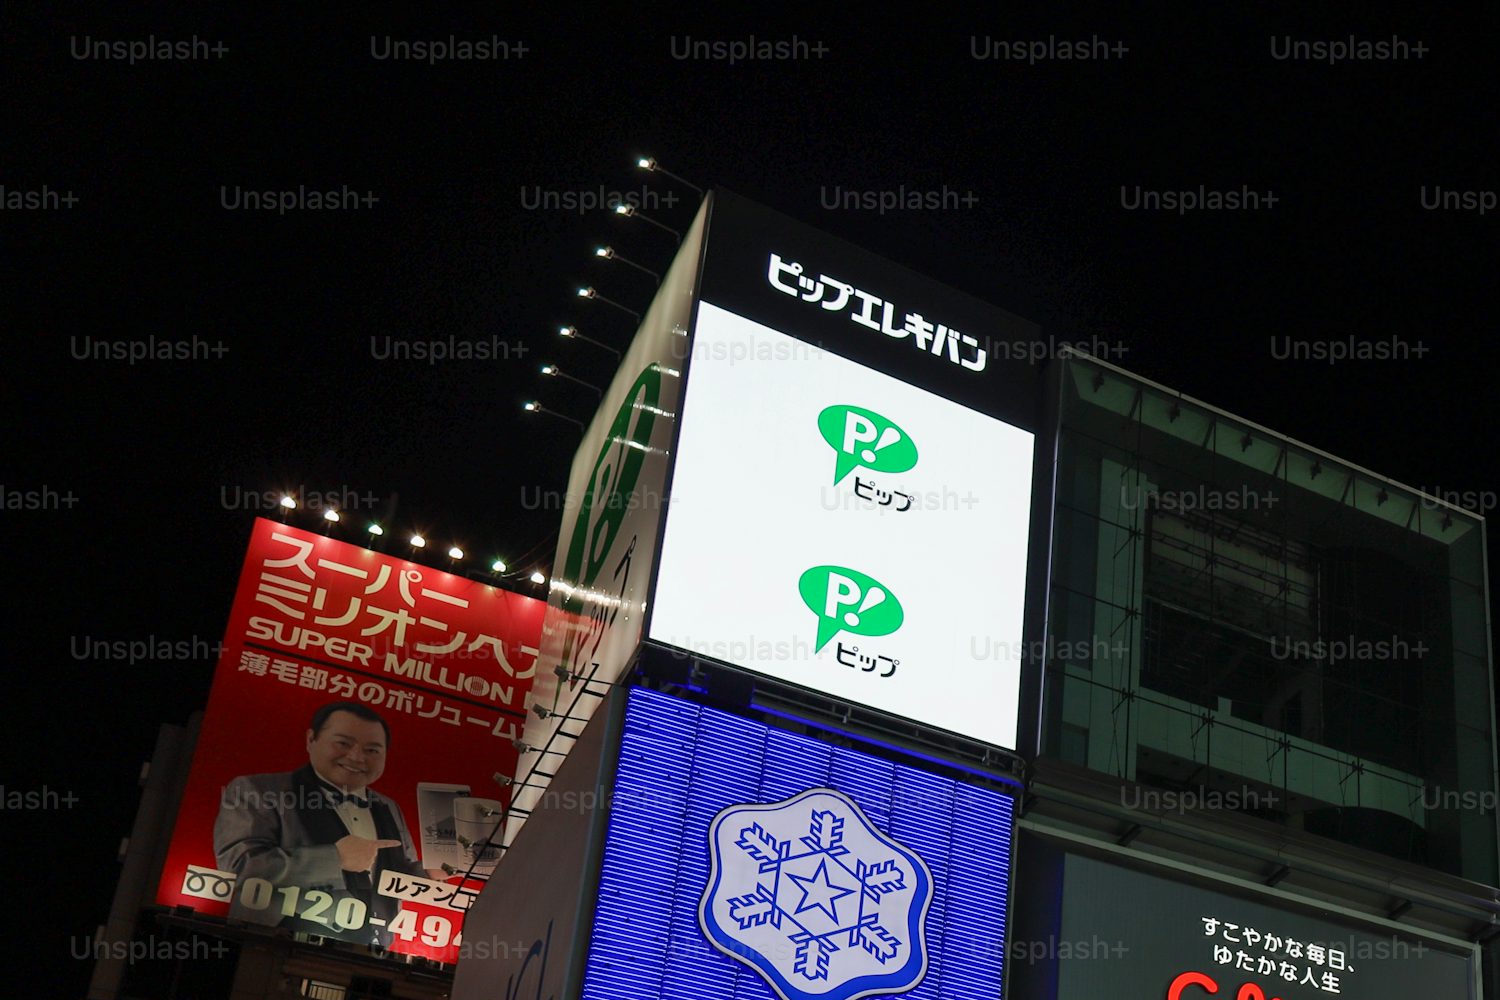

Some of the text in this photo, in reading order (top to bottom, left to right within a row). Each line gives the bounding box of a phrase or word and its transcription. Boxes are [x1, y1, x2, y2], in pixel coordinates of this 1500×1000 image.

[767, 252, 987, 372] ピップエレキバン
[853, 476, 915, 513] ピップ
[261, 531, 470, 610] スーパー
[245, 616, 514, 706] SUPER MILLION
[836, 641, 901, 678] ピップ
[237, 649, 525, 741] 薄毛部分のボリューム
[1202, 917, 1356, 972] すこやかな毎日、
[1213, 946, 1341, 994] ゆたかな人生
